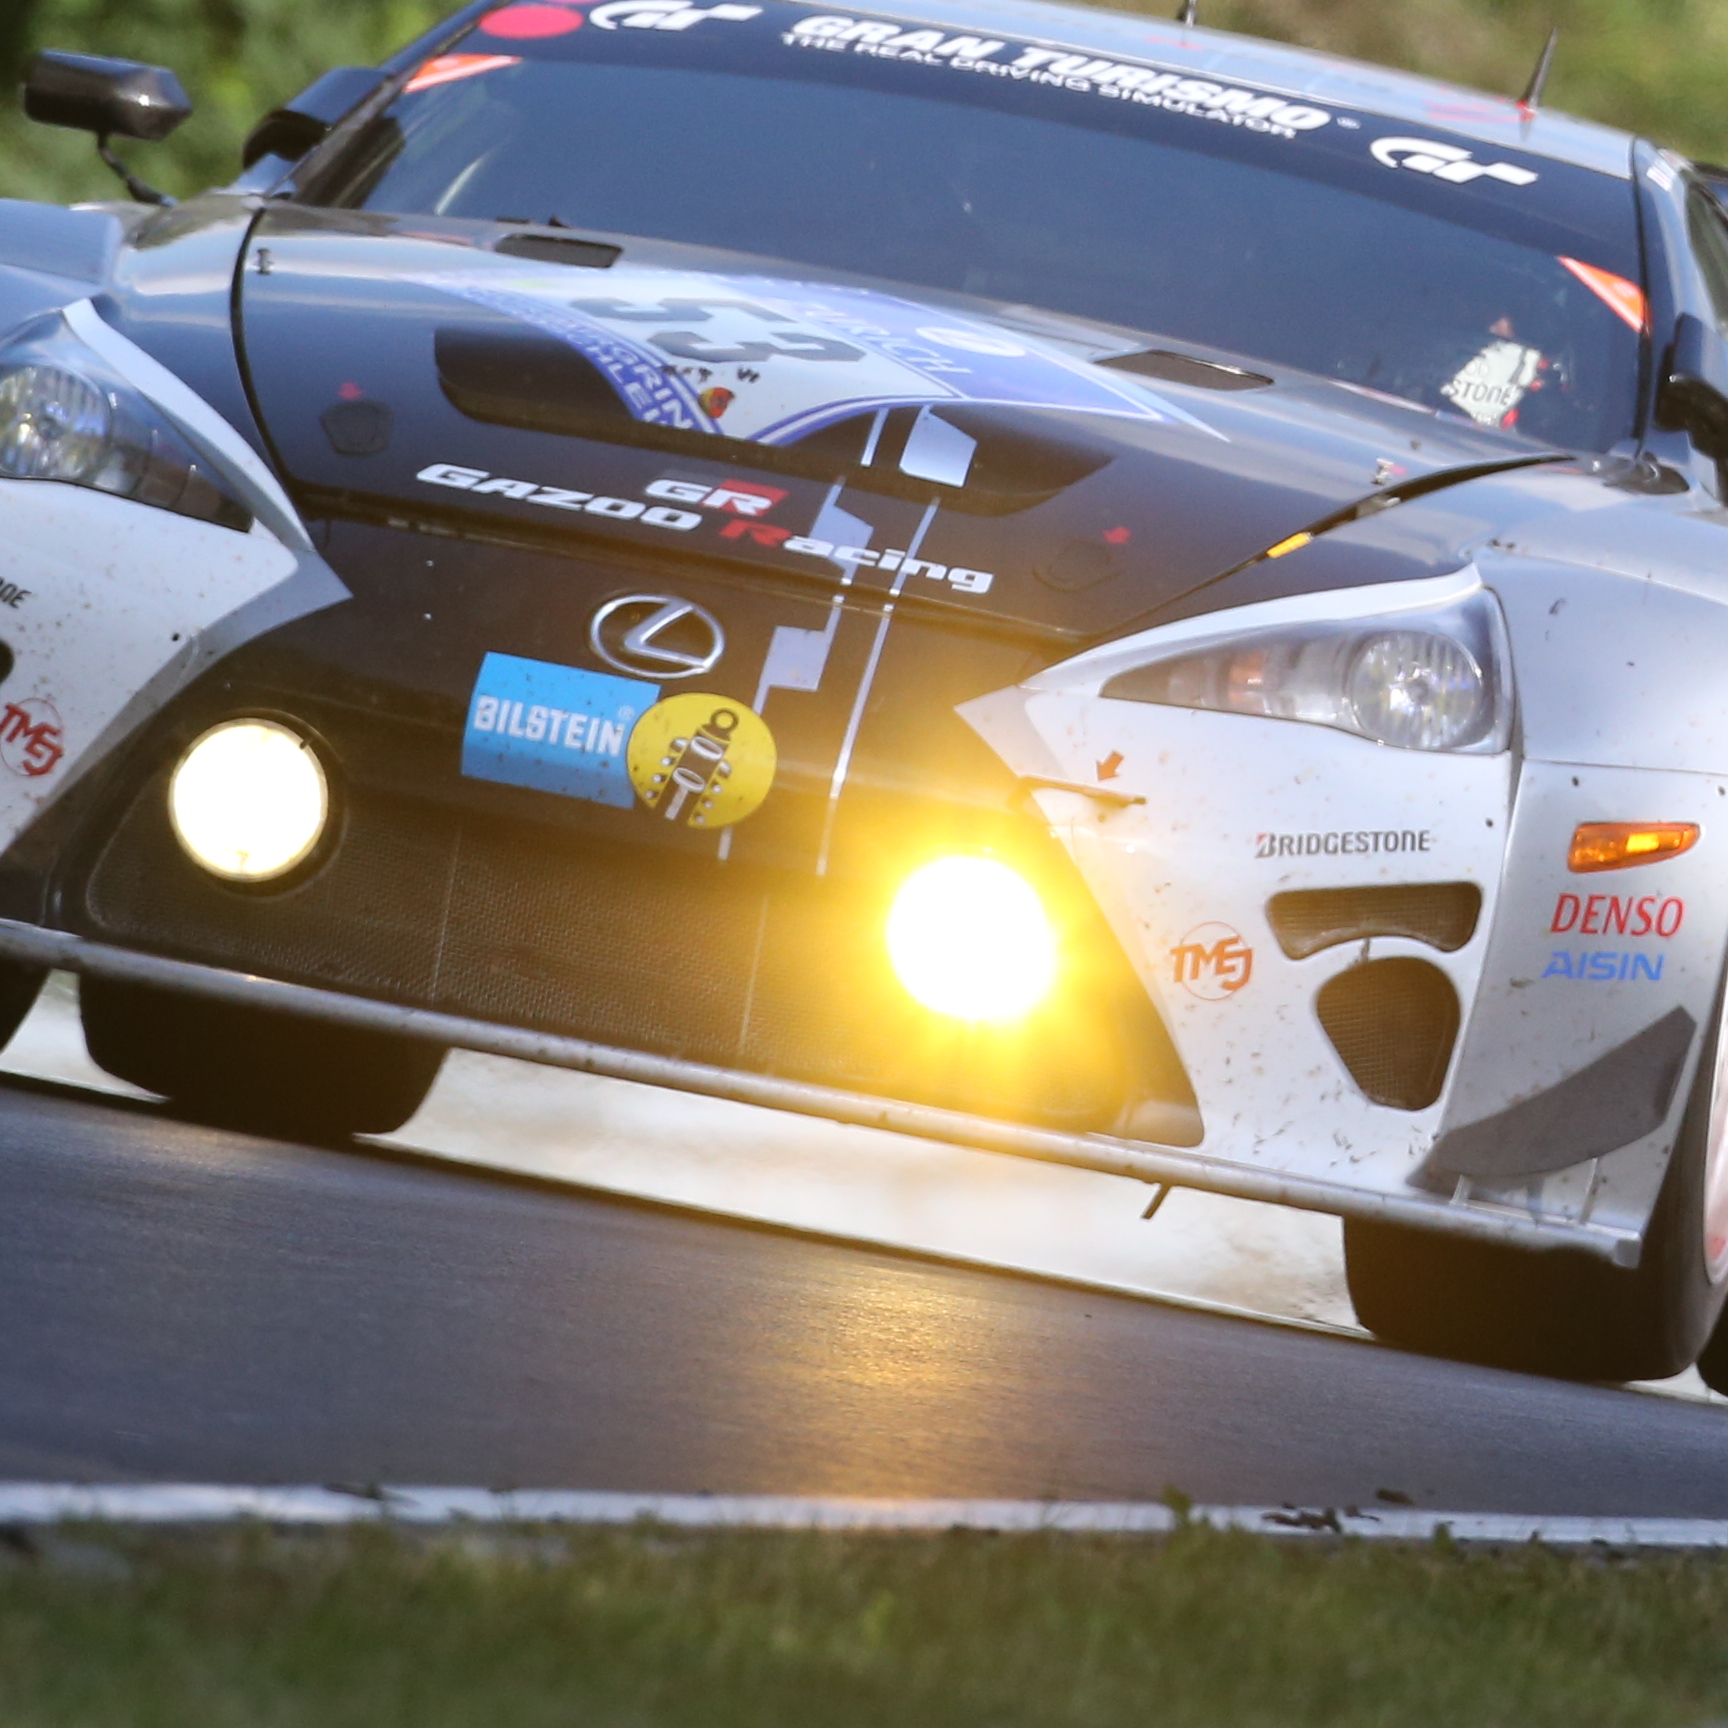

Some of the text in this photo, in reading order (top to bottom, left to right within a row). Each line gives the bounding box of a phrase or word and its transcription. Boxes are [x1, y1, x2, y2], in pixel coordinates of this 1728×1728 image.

[781, 31, 1297, 140] THE REAL DRIVING SIMULATOR
[792, 15, 1331, 130] GRAN TURISMO
[645, 479, 773, 517] GR
[416, 463, 995, 595] GAZOO Racing
[474, 695, 626, 758] BILSTEIN
[1255, 829, 1431, 859] BRIDGESTONE
[1550, 892, 1685, 938] DENSO
[1541, 950, 1665, 982] AISIN
